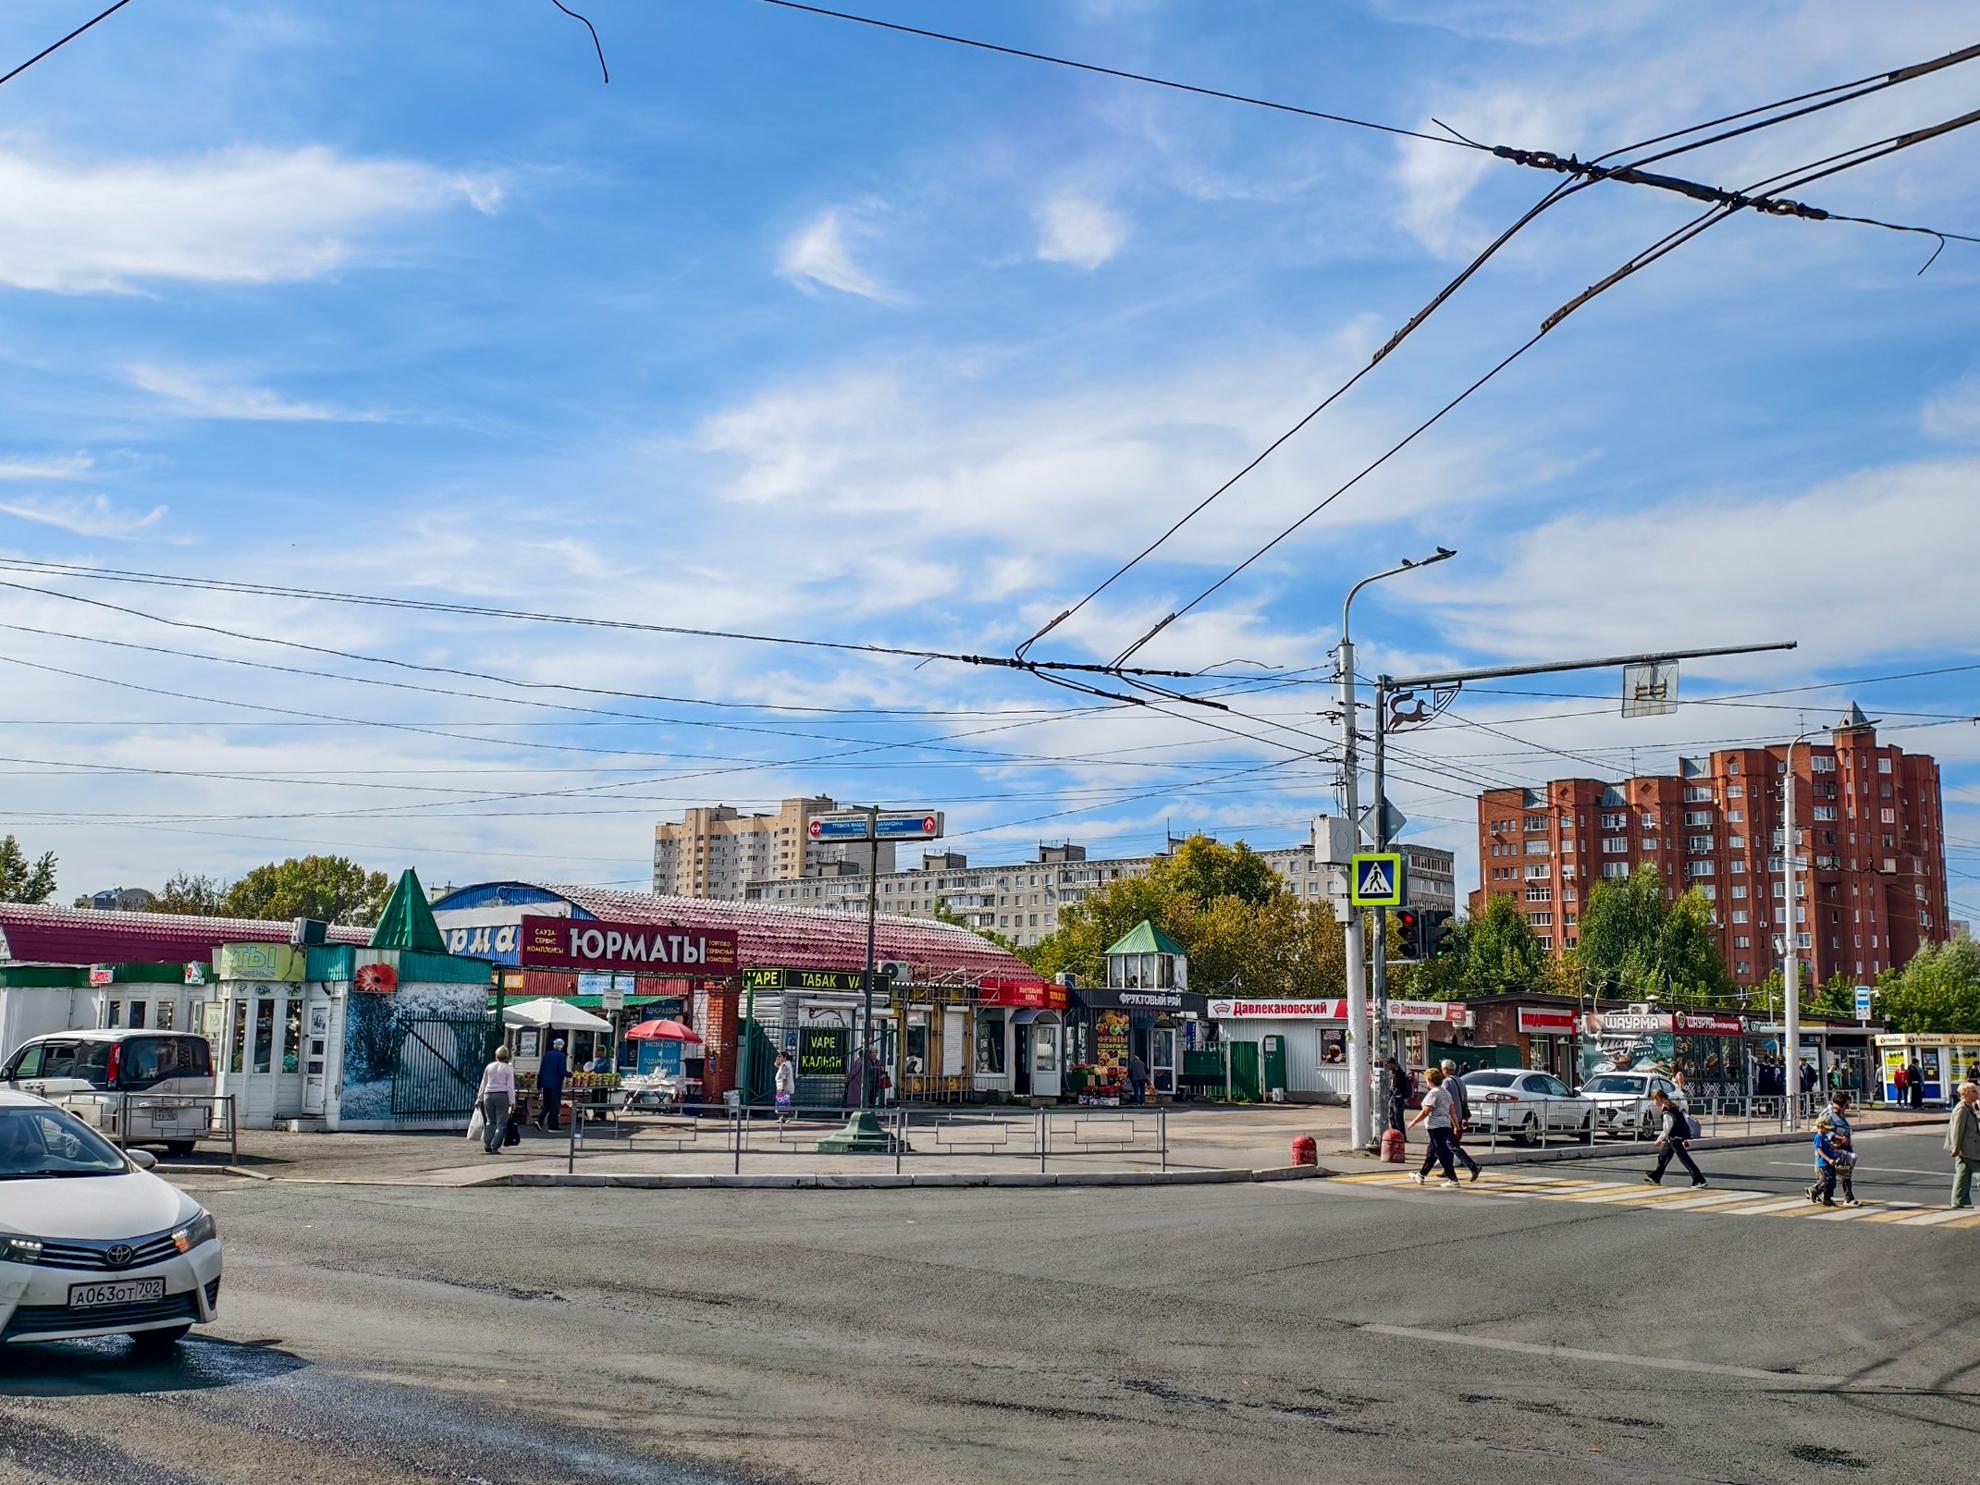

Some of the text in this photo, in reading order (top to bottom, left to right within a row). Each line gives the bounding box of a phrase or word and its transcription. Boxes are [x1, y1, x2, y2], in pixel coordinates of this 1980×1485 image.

[569, 928, 706, 964] ЮРМАТЫ
[802, 973, 837, 988] ТАБАК
[1118, 992, 1182, 1007] ФРУКТОВЫЙ РАЙ
[1234, 1001, 1327, 1016] Давлекановский
[1604, 1016, 1659, 1029] ШАУРМА
[811, 1036, 836, 1048] VAPE
[76, 1282, 160, 1304] А063ОТ 702
